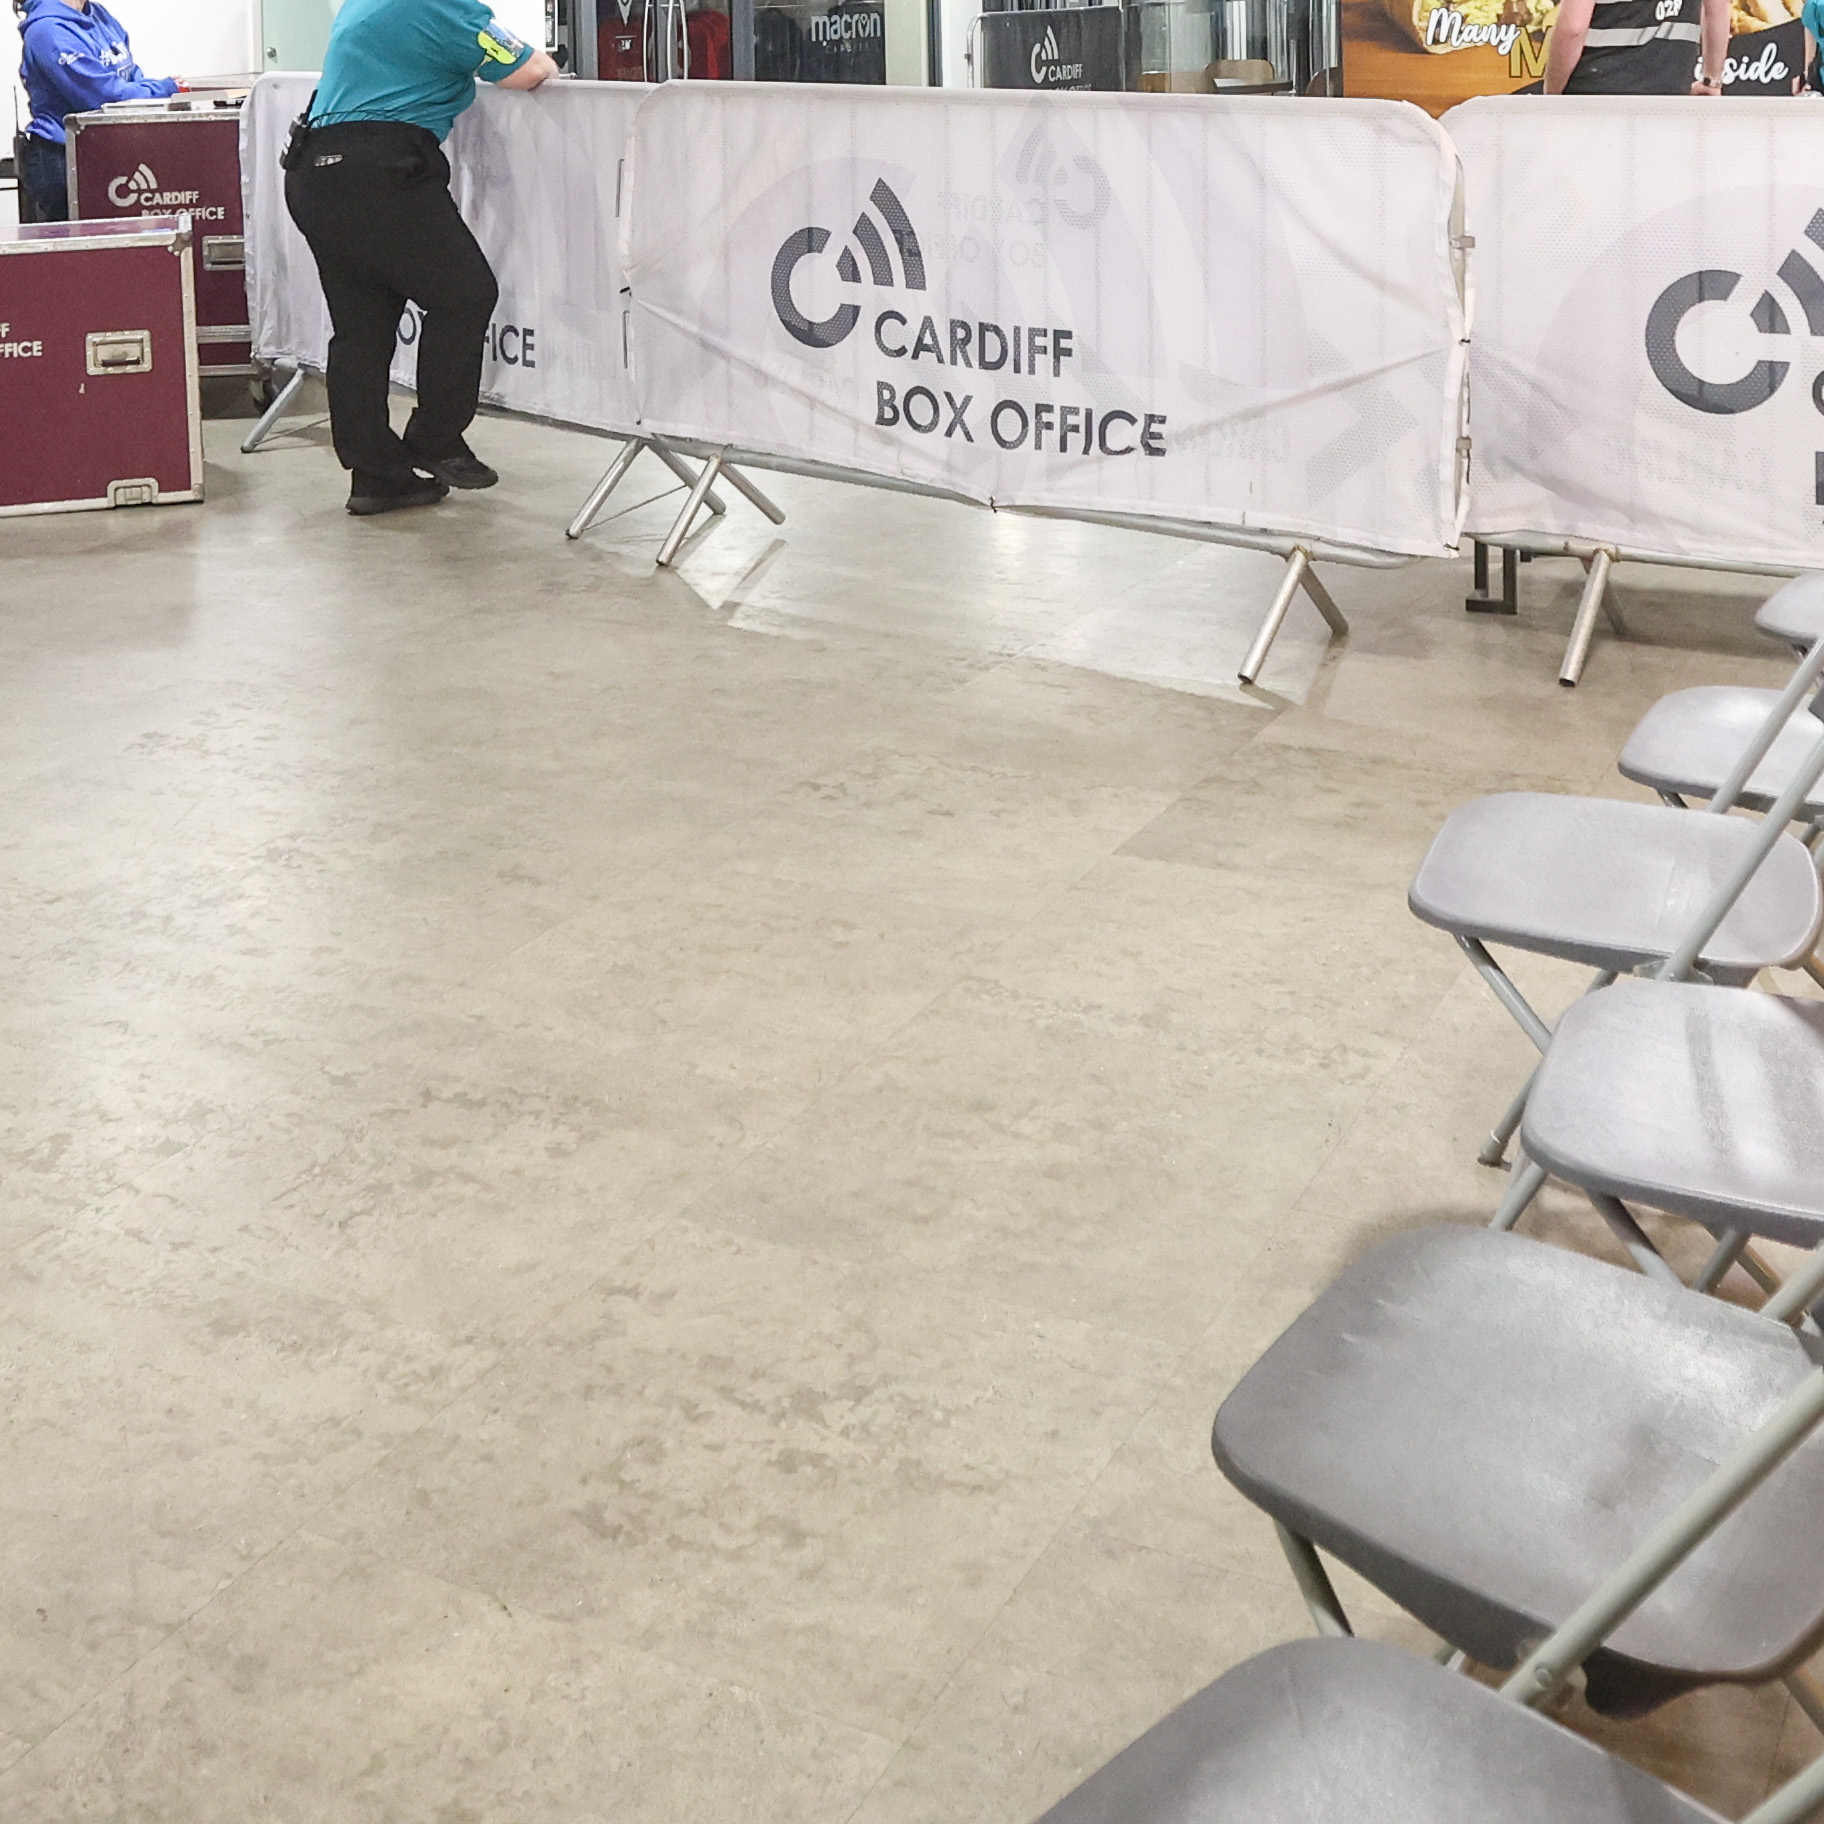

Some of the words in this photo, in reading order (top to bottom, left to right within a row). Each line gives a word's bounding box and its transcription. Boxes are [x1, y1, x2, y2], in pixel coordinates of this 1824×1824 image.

[811, 12, 881, 42] macron
[1426, 7, 1521, 55] Many
[1048, 63, 1083, 82] CARDIFF
[1694, 42, 1789, 85] iside
[140, 190, 200, 206] CARDIFF
[874, 309, 1074, 379] CARDIFF
[874, 381, 975, 444] BOX
[990, 399, 1168, 457] OFFICE
